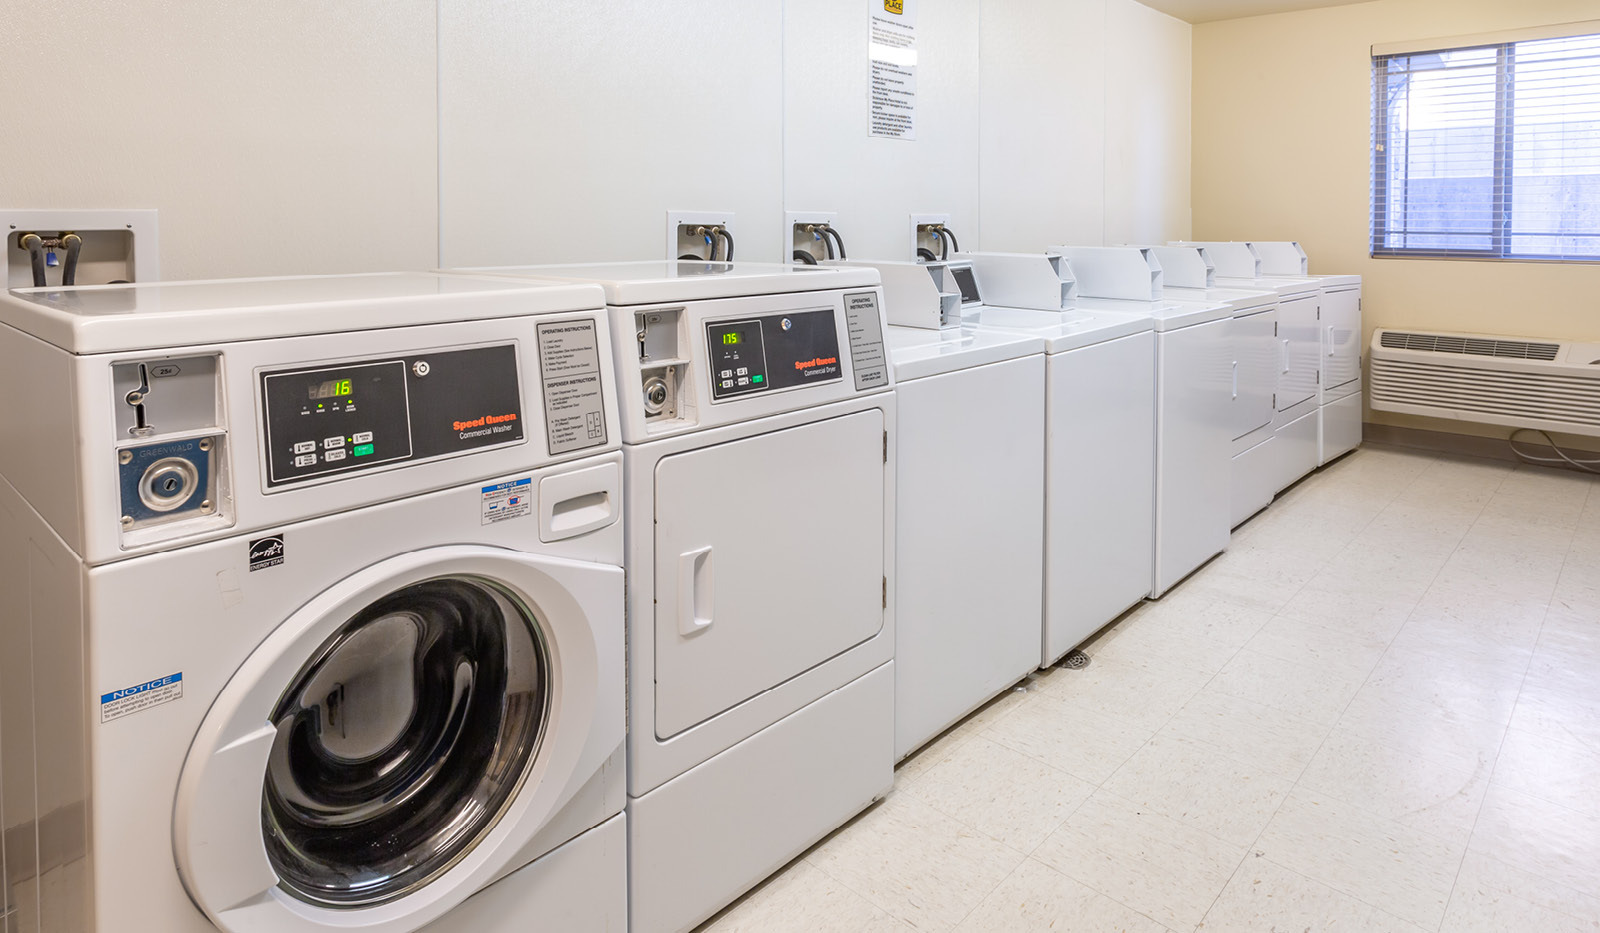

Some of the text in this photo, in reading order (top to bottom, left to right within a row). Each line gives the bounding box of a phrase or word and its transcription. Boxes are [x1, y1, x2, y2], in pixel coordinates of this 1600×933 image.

[886, 1, 902, 10] PLACE
[723, 333, 736, 344] 175
[795, 357, 836, 370] Speed Queen
[804, 368, 825, 376] Commercial
[335, 381, 350, 396] 16
[453, 414, 517, 431] Speed Queen
[460, 425, 512, 439] Commercial Washer
[139, 443, 192, 457] GREENWALD
[250, 562, 270, 571] ENERGY
[113, 676, 172, 699] NOTICE
[121, 696, 136, 704] LOCK
